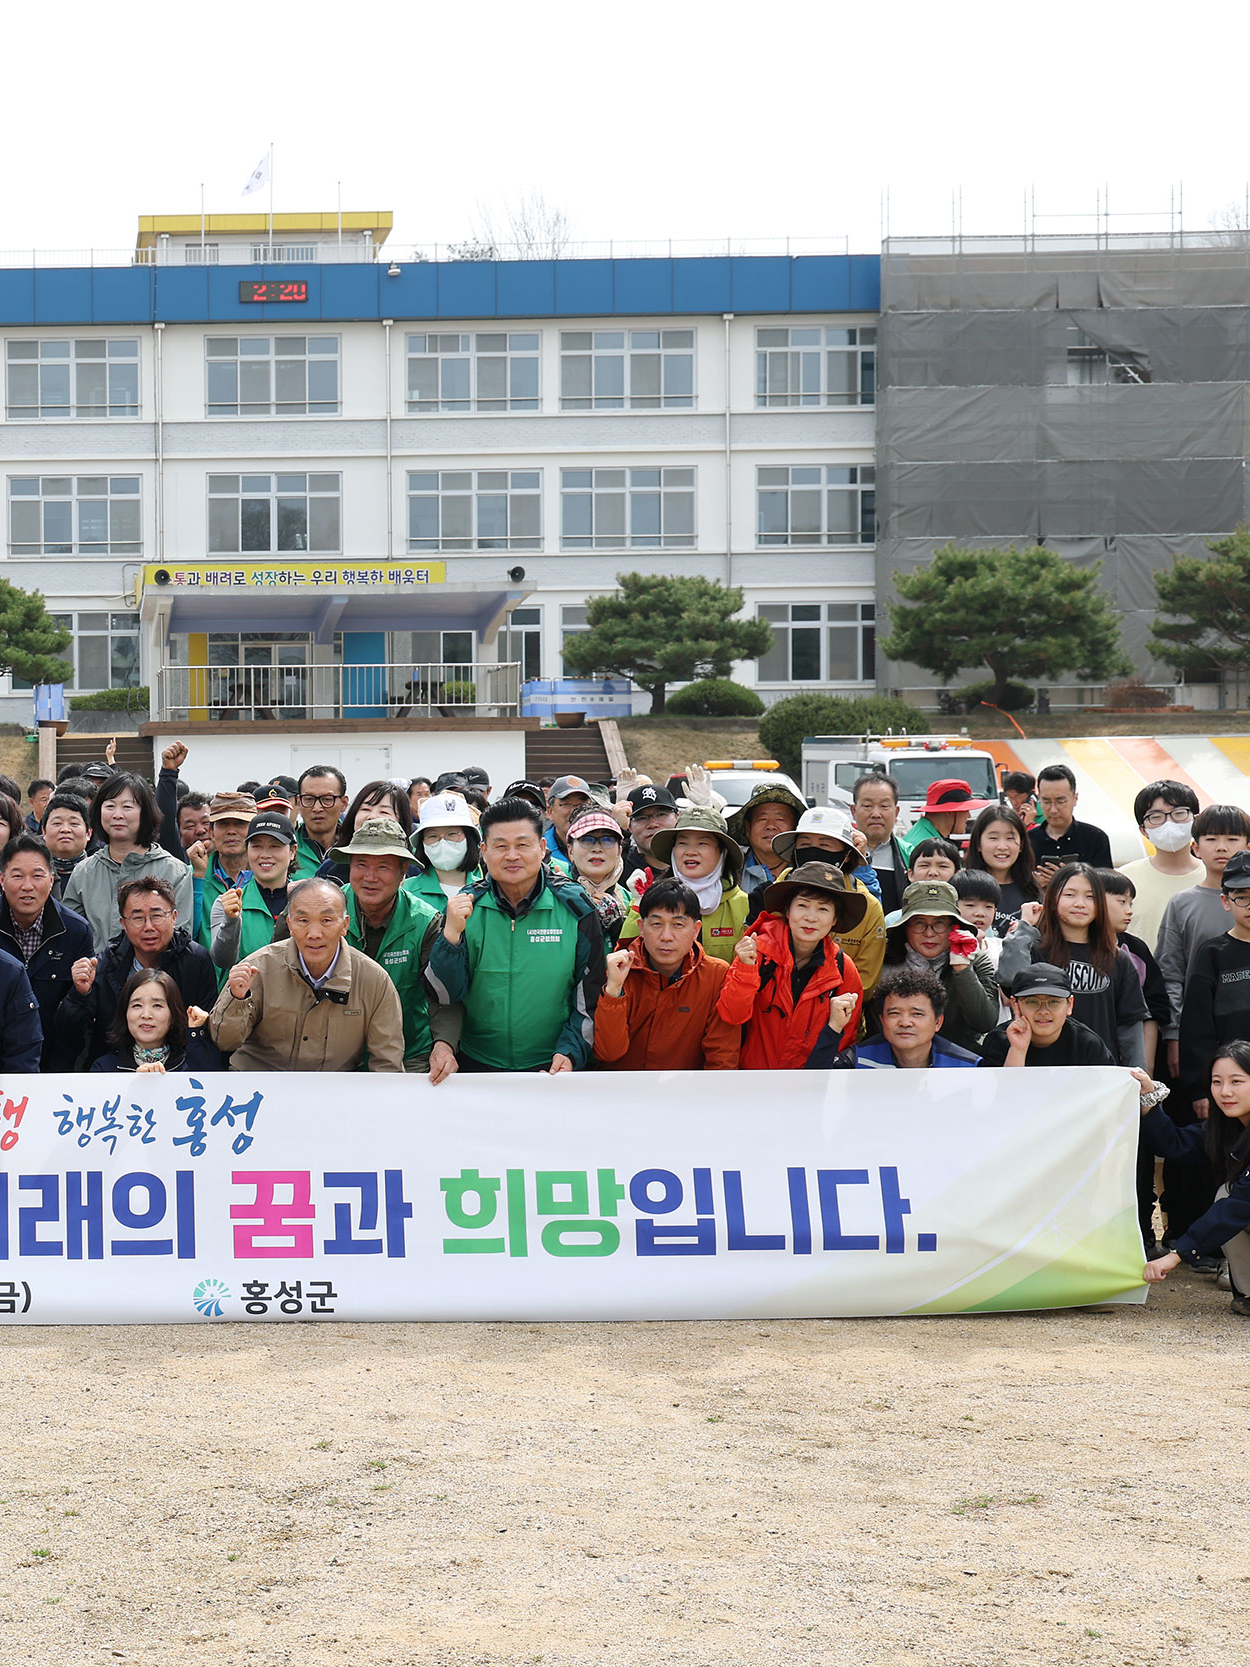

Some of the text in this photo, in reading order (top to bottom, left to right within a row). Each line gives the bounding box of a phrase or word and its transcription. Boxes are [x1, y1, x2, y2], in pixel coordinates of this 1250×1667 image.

[168, 571, 200, 586] 통과
[205, 571, 247, 586] 배려로
[250, 570, 306, 586] 성장하는
[310, 570, 338, 586] 우리
[52, 1093, 158, 1156] 행복한
[171, 1077, 264, 1158] 홍성
[229, 1168, 414, 1260] 꿈과
[438, 1166, 938, 1258] 희망입니다.
[239, 1278, 338, 1316] 홍성군
